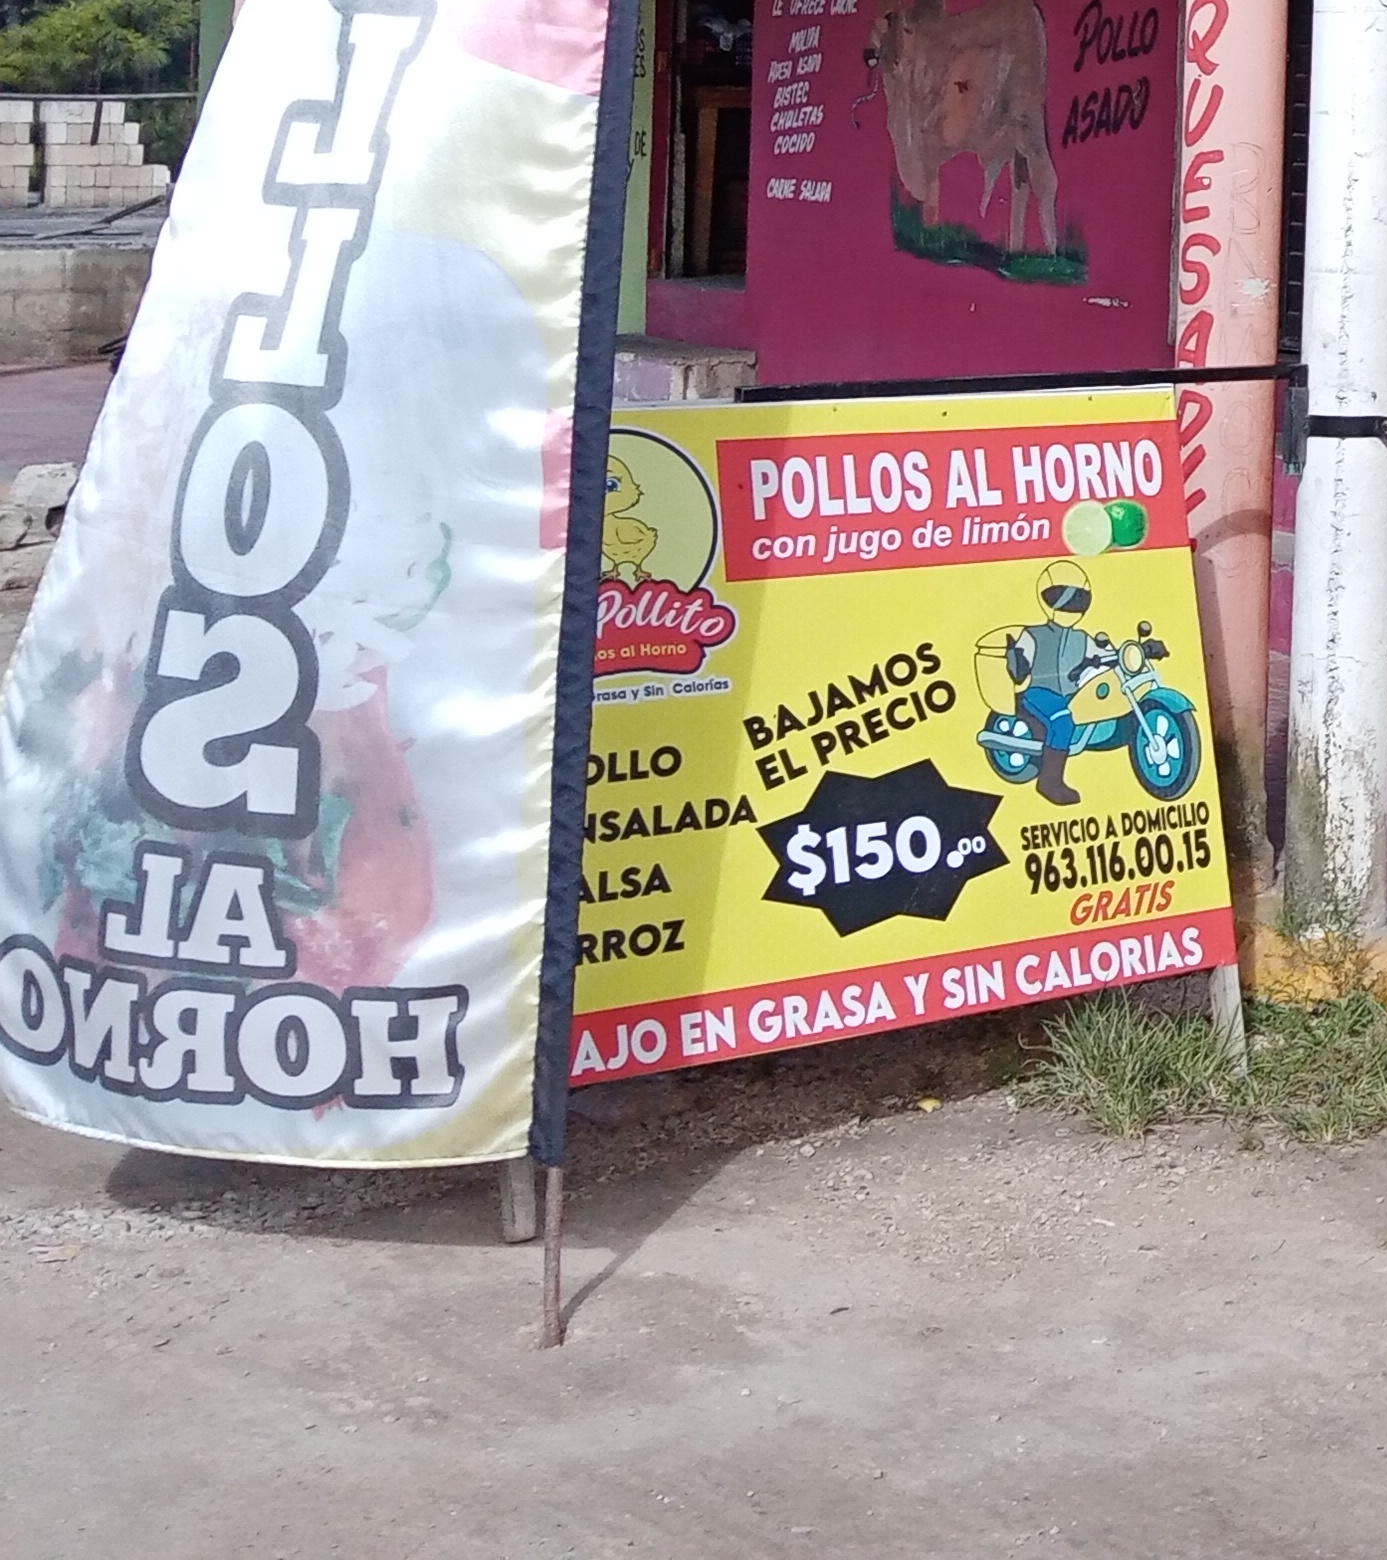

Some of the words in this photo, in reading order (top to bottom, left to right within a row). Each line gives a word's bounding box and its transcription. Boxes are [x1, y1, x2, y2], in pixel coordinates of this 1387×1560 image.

[770, 104, 824, 132] CHULETAS
[774, 81, 809, 109] BISTEC
[1061, 76, 1150, 149] ASADO
[774, 132, 815, 155] COCIDO
[749, 450, 933, 521] POLLOS
[945, 448, 1003, 509] AL
[1012, 439, 1163, 505] HORNO
[751, 533, 816, 561] con
[822, 526, 902, 563] jugo
[912, 520, 953, 549] de
[962, 512, 1051, 546] limón
[596, 589, 725, 640] Pollito
[620, 646, 636, 658] al
[640, 643, 687, 656] Horno
[594, 692, 627, 702] rasa
[631, 689, 640, 700] y
[644, 685, 664, 697] Sin
[672, 678, 730, 694] Calorías
[742, 642, 942, 751] BAJAMOS
[755, 748, 809, 791] EL
[811, 680, 957, 767] PRECIO
[586, 745, 682, 786] OLLO
[1020, 816, 1100, 851] SERVICIO
[1105, 814, 1118, 839] A
[1120, 801, 1210, 837] DOMICILIO
[578, 863, 673, 905] ALSA
[1025, 828, 1211, 895] 963.116.00.15
[1069, 879, 1176, 926] GRATIS
[575, 919, 686, 967] RROZ
[570, 1017, 668, 1077] AJO
[680, 1005, 737, 1058] EN
[747, 982, 897, 1045] GRASA
[906, 971, 931, 1016] Y
[941, 960, 1005, 1009] SIN
[1014, 926, 1204, 996] CALORIAS
